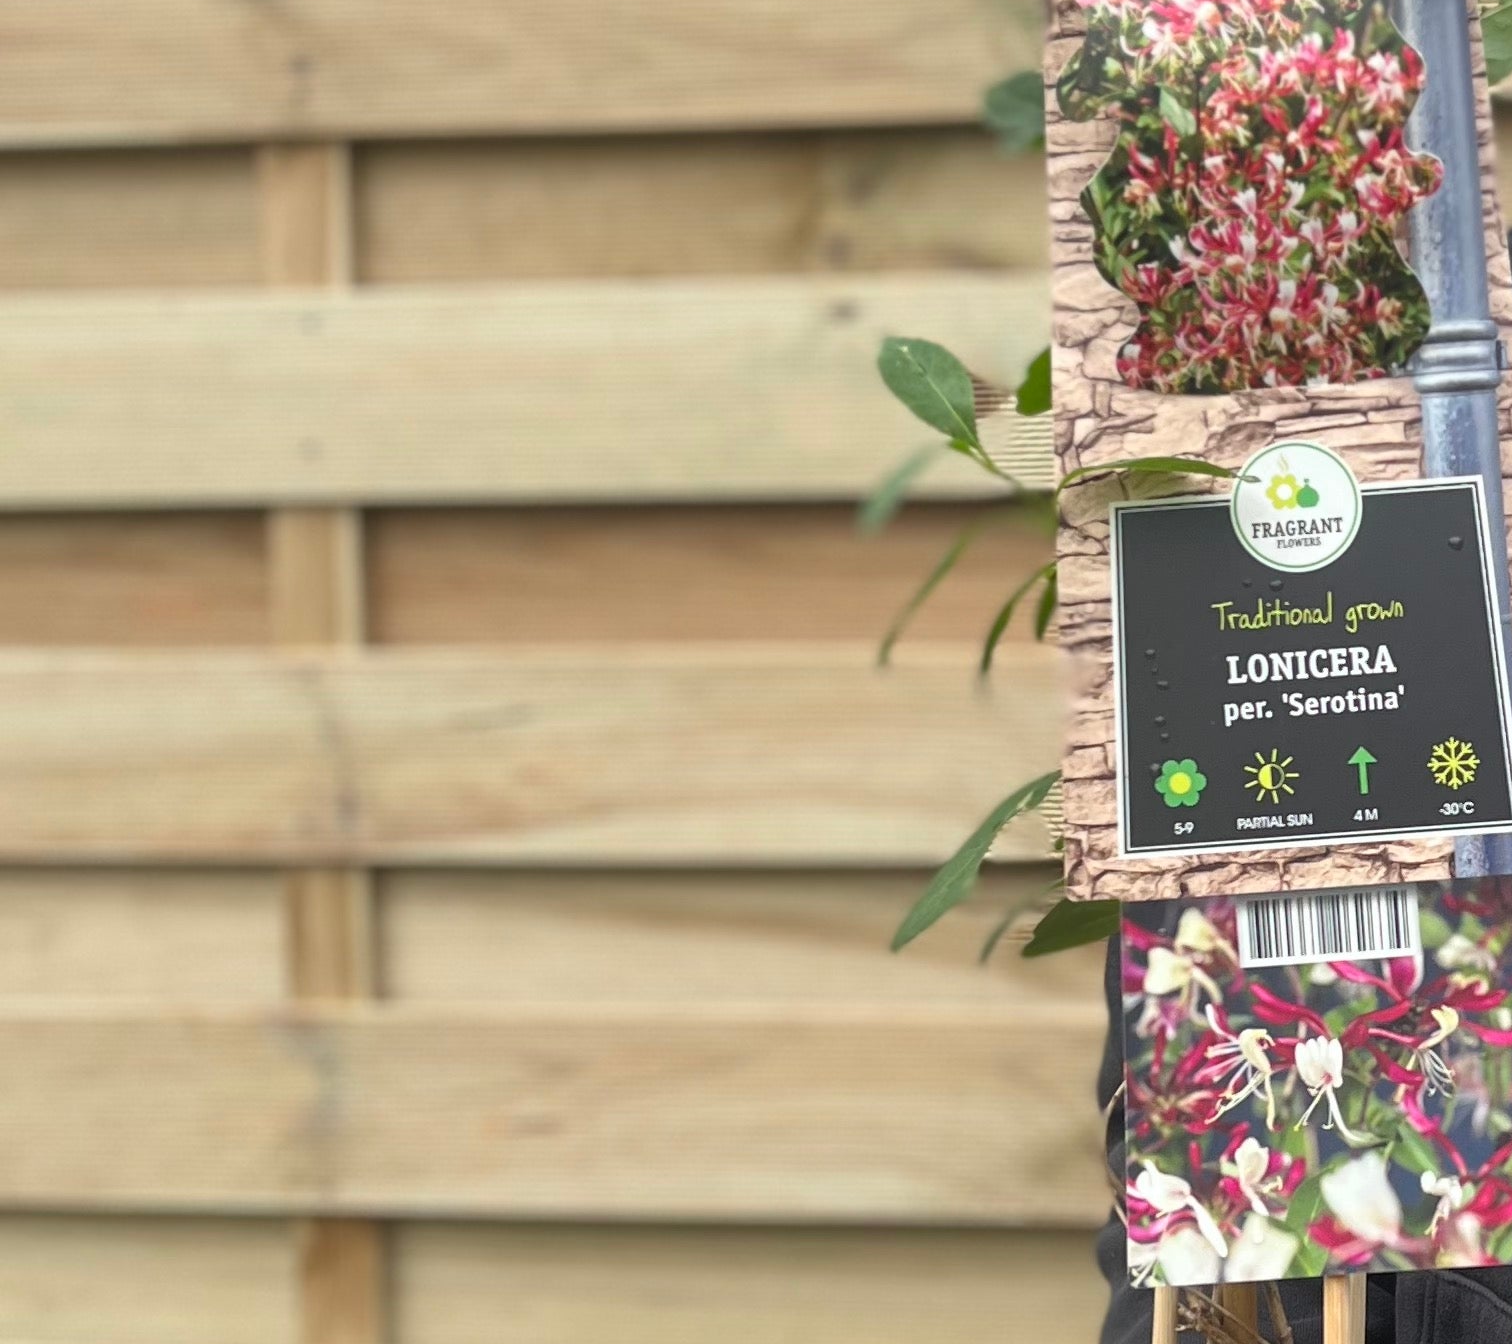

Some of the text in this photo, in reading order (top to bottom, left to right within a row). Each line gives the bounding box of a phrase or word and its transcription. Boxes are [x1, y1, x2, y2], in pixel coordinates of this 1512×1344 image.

[1251, 517, 1343, 538] FRAGRANT
[1276, 537, 1322, 549] FLOWERS
[1211, 591, 1405, 633] Traditional grown
[1226, 645, 1397, 684] LONICERA
[1223, 684, 1405, 727] per. 'Serotina'
[1173, 821, 1195, 835] 5-9
[1236, 813, 1314, 830] PARTIAL SUN
